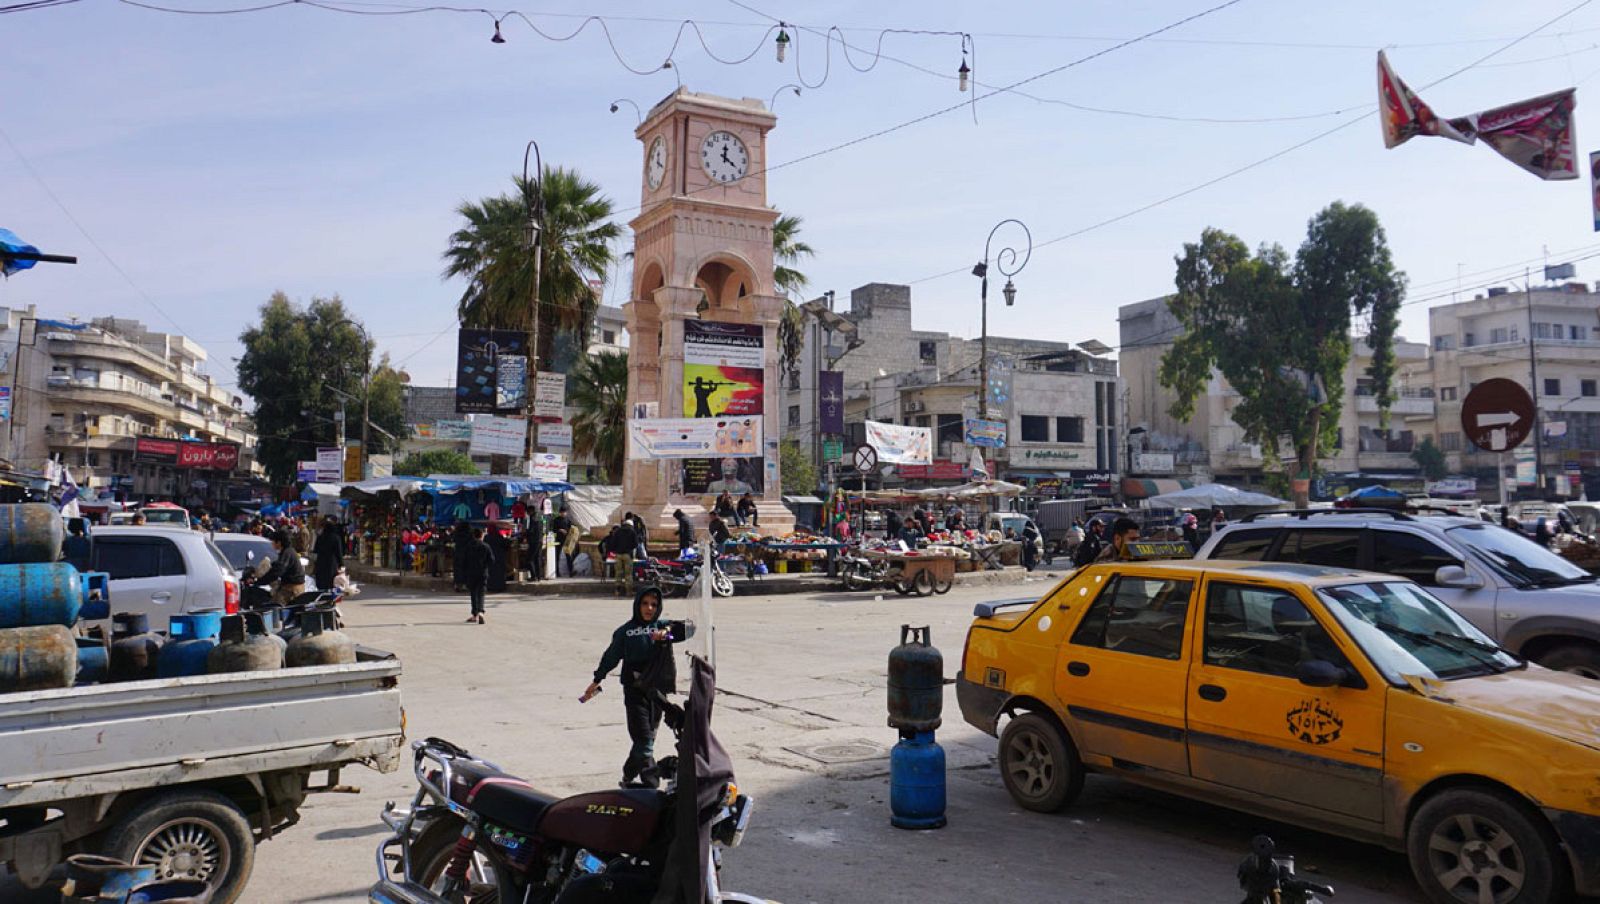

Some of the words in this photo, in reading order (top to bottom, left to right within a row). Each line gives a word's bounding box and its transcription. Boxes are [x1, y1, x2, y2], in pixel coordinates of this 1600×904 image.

[183, 447, 212, 462] بارون
[625, 625, 658, 637] adida
[1288, 721, 1341, 745] TAXI
[585, 804, 635, 817] PART
